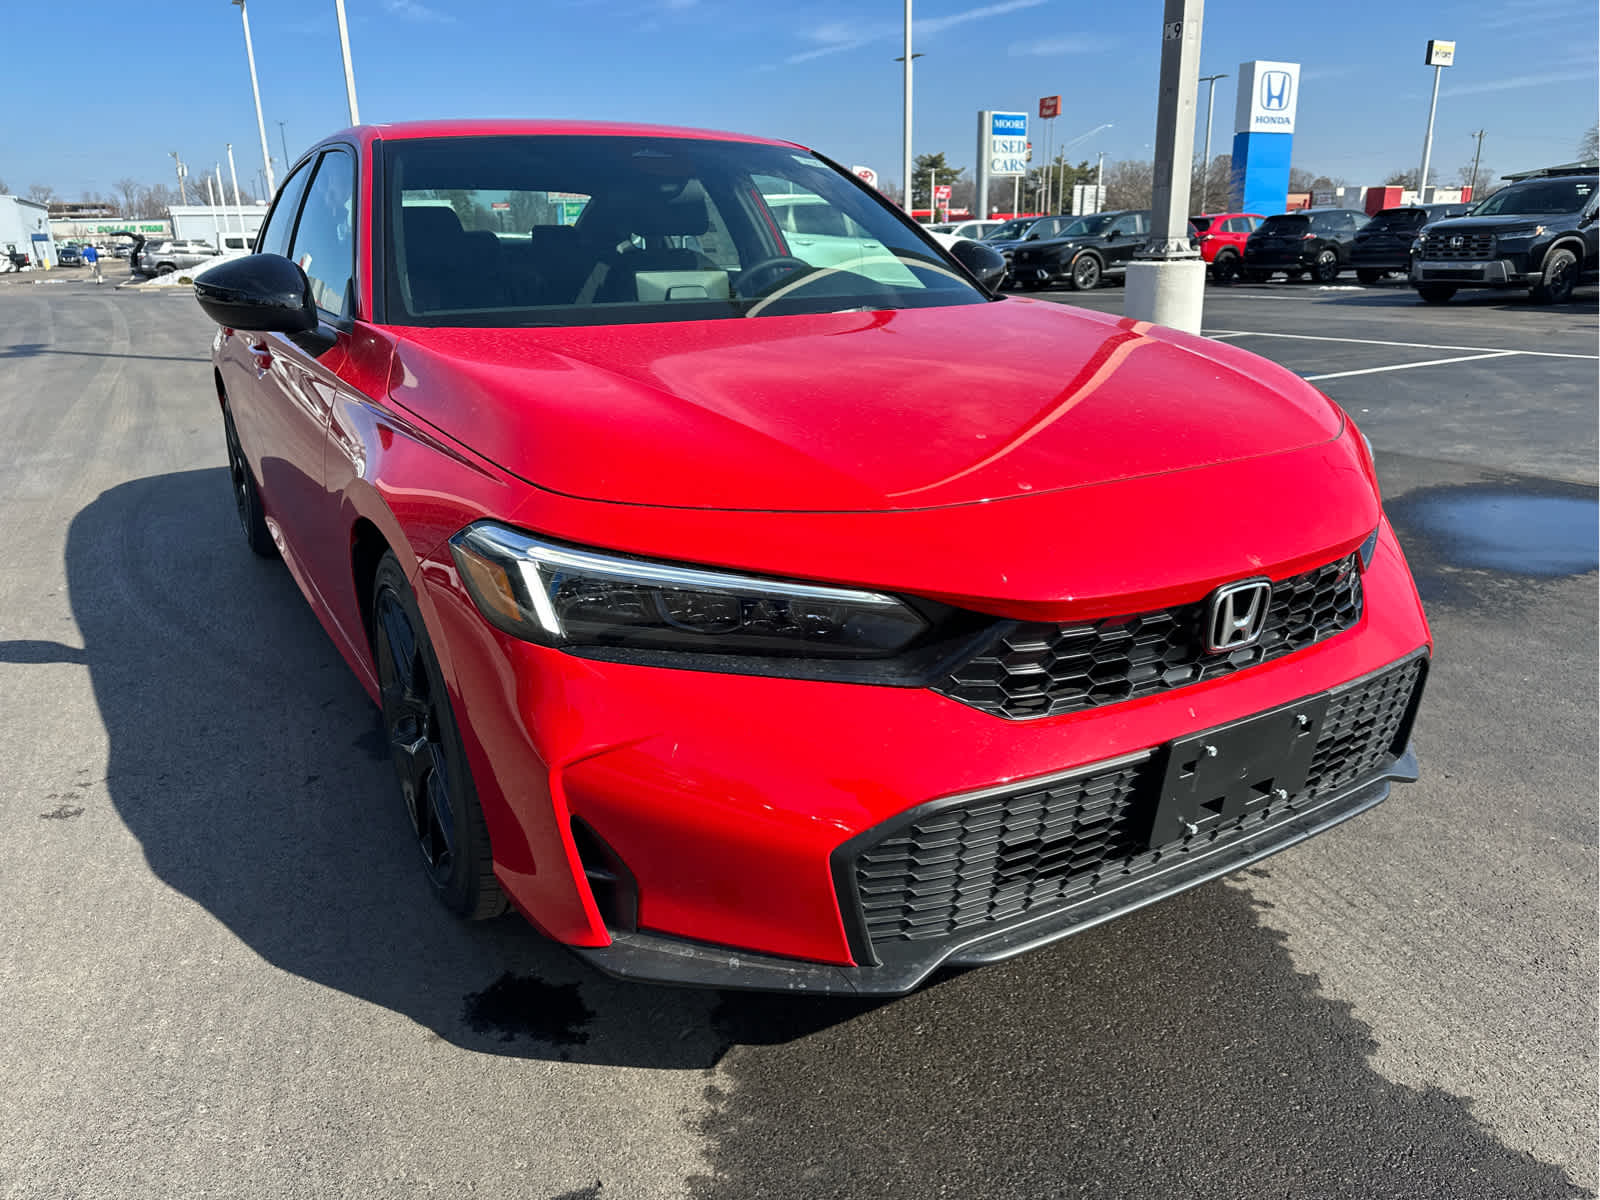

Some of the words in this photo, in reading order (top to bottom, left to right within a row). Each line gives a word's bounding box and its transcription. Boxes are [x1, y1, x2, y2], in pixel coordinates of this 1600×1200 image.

[993, 119, 1026, 129] MOORE
[1255, 115, 1291, 125] HONDA
[992, 140, 1026, 153] USED
[991, 159, 1025, 171] CARS
